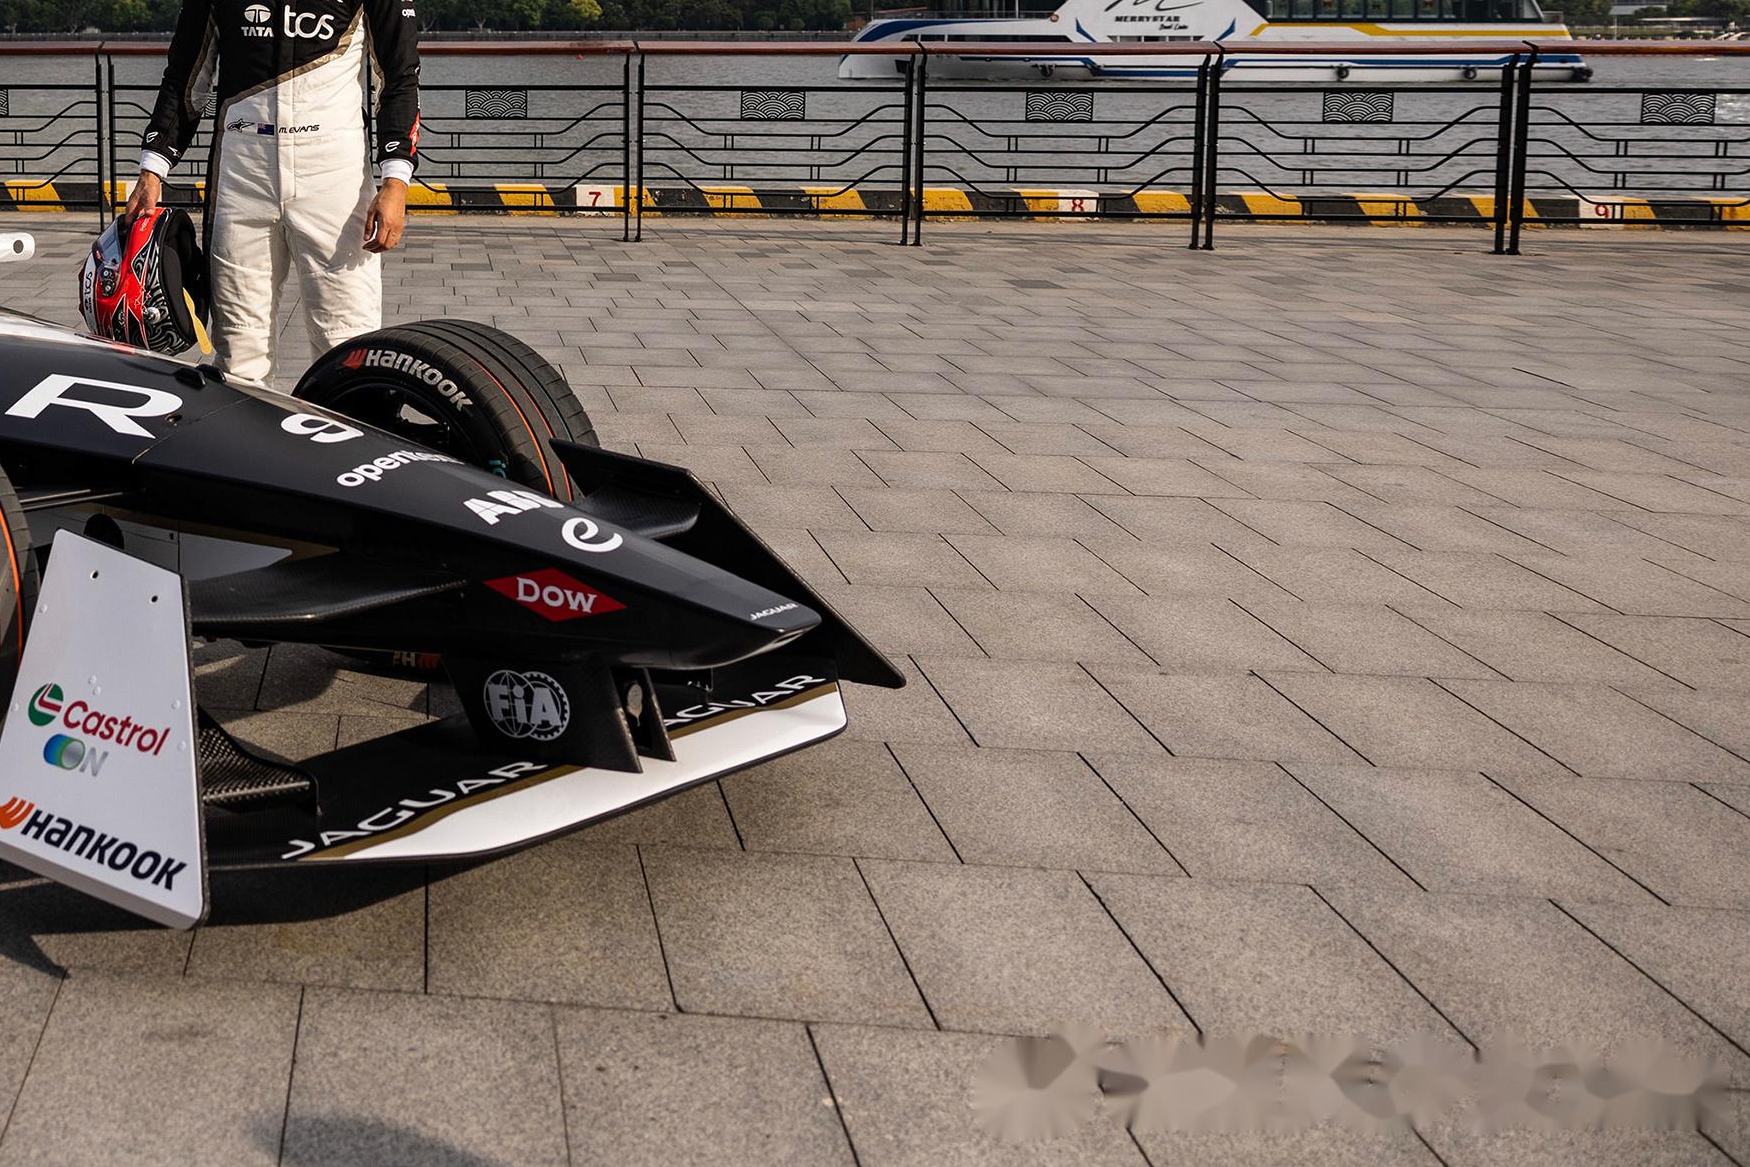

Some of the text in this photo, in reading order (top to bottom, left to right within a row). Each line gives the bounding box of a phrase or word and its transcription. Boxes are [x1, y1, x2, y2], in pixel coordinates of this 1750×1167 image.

[241, 4, 335, 41] TATA tcs
[1114, 15, 1181, 23] MERRYSTAR
[588, 191, 602, 207] 7
[1071, 197, 1085, 213] 8
[663, 674, 827, 729] AGUAR
[62, 699, 171, 757] Castrol
[281, 760, 548, 861] JAGUAR
